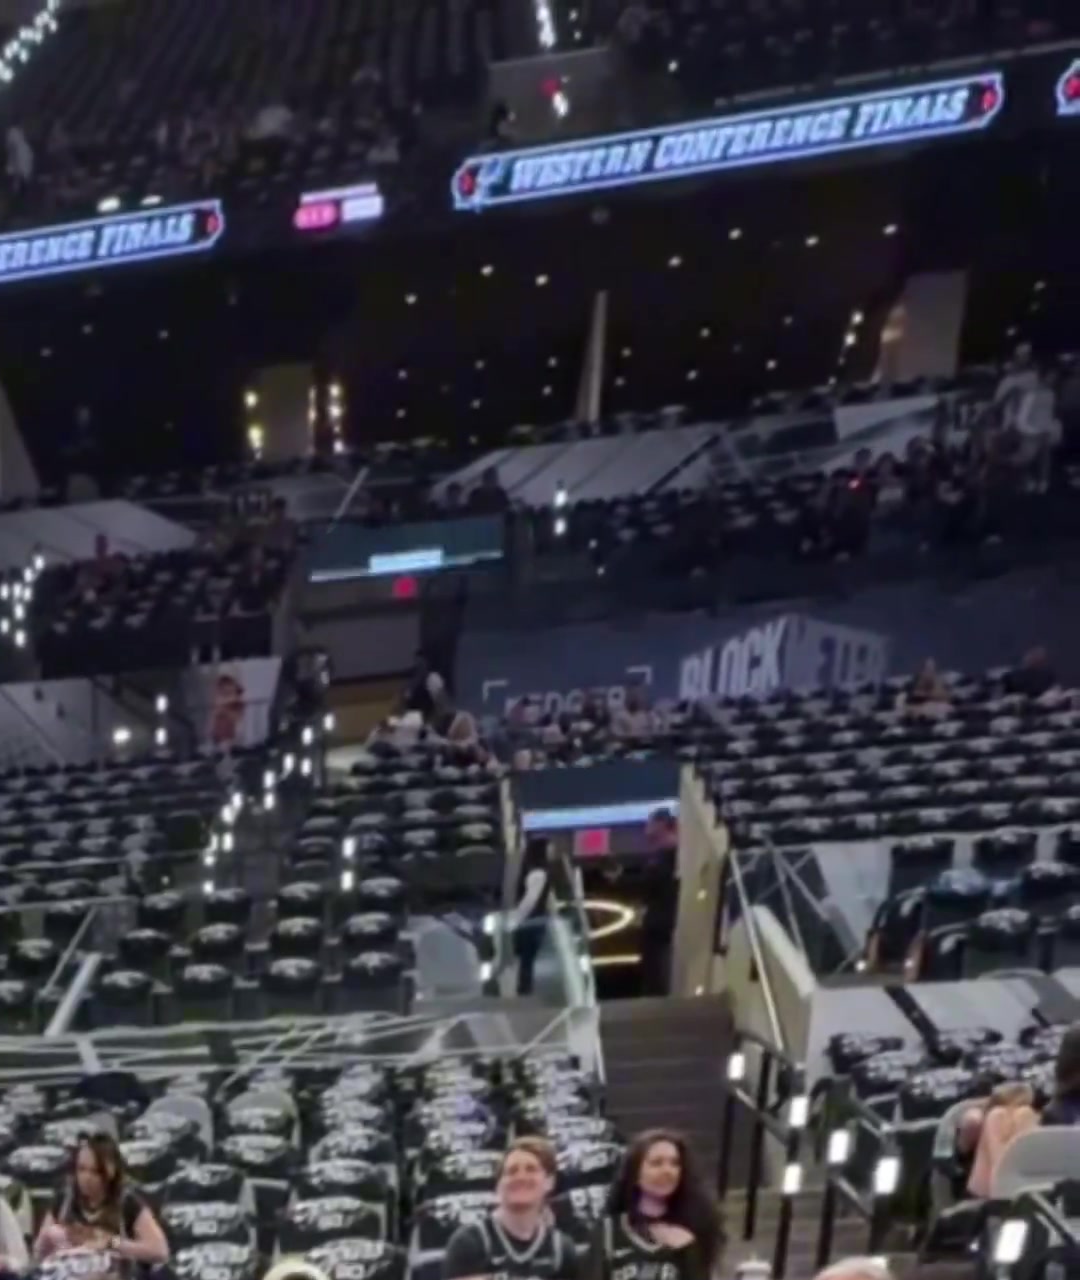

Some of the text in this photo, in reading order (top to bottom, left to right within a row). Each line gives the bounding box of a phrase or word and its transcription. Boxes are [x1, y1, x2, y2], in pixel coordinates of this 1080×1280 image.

[510, 88, 970, 192] WESTERN CONFERENCE FINALS
[95, 213, 196, 257] FINALS
[679, 616, 788, 700] BLOCK
